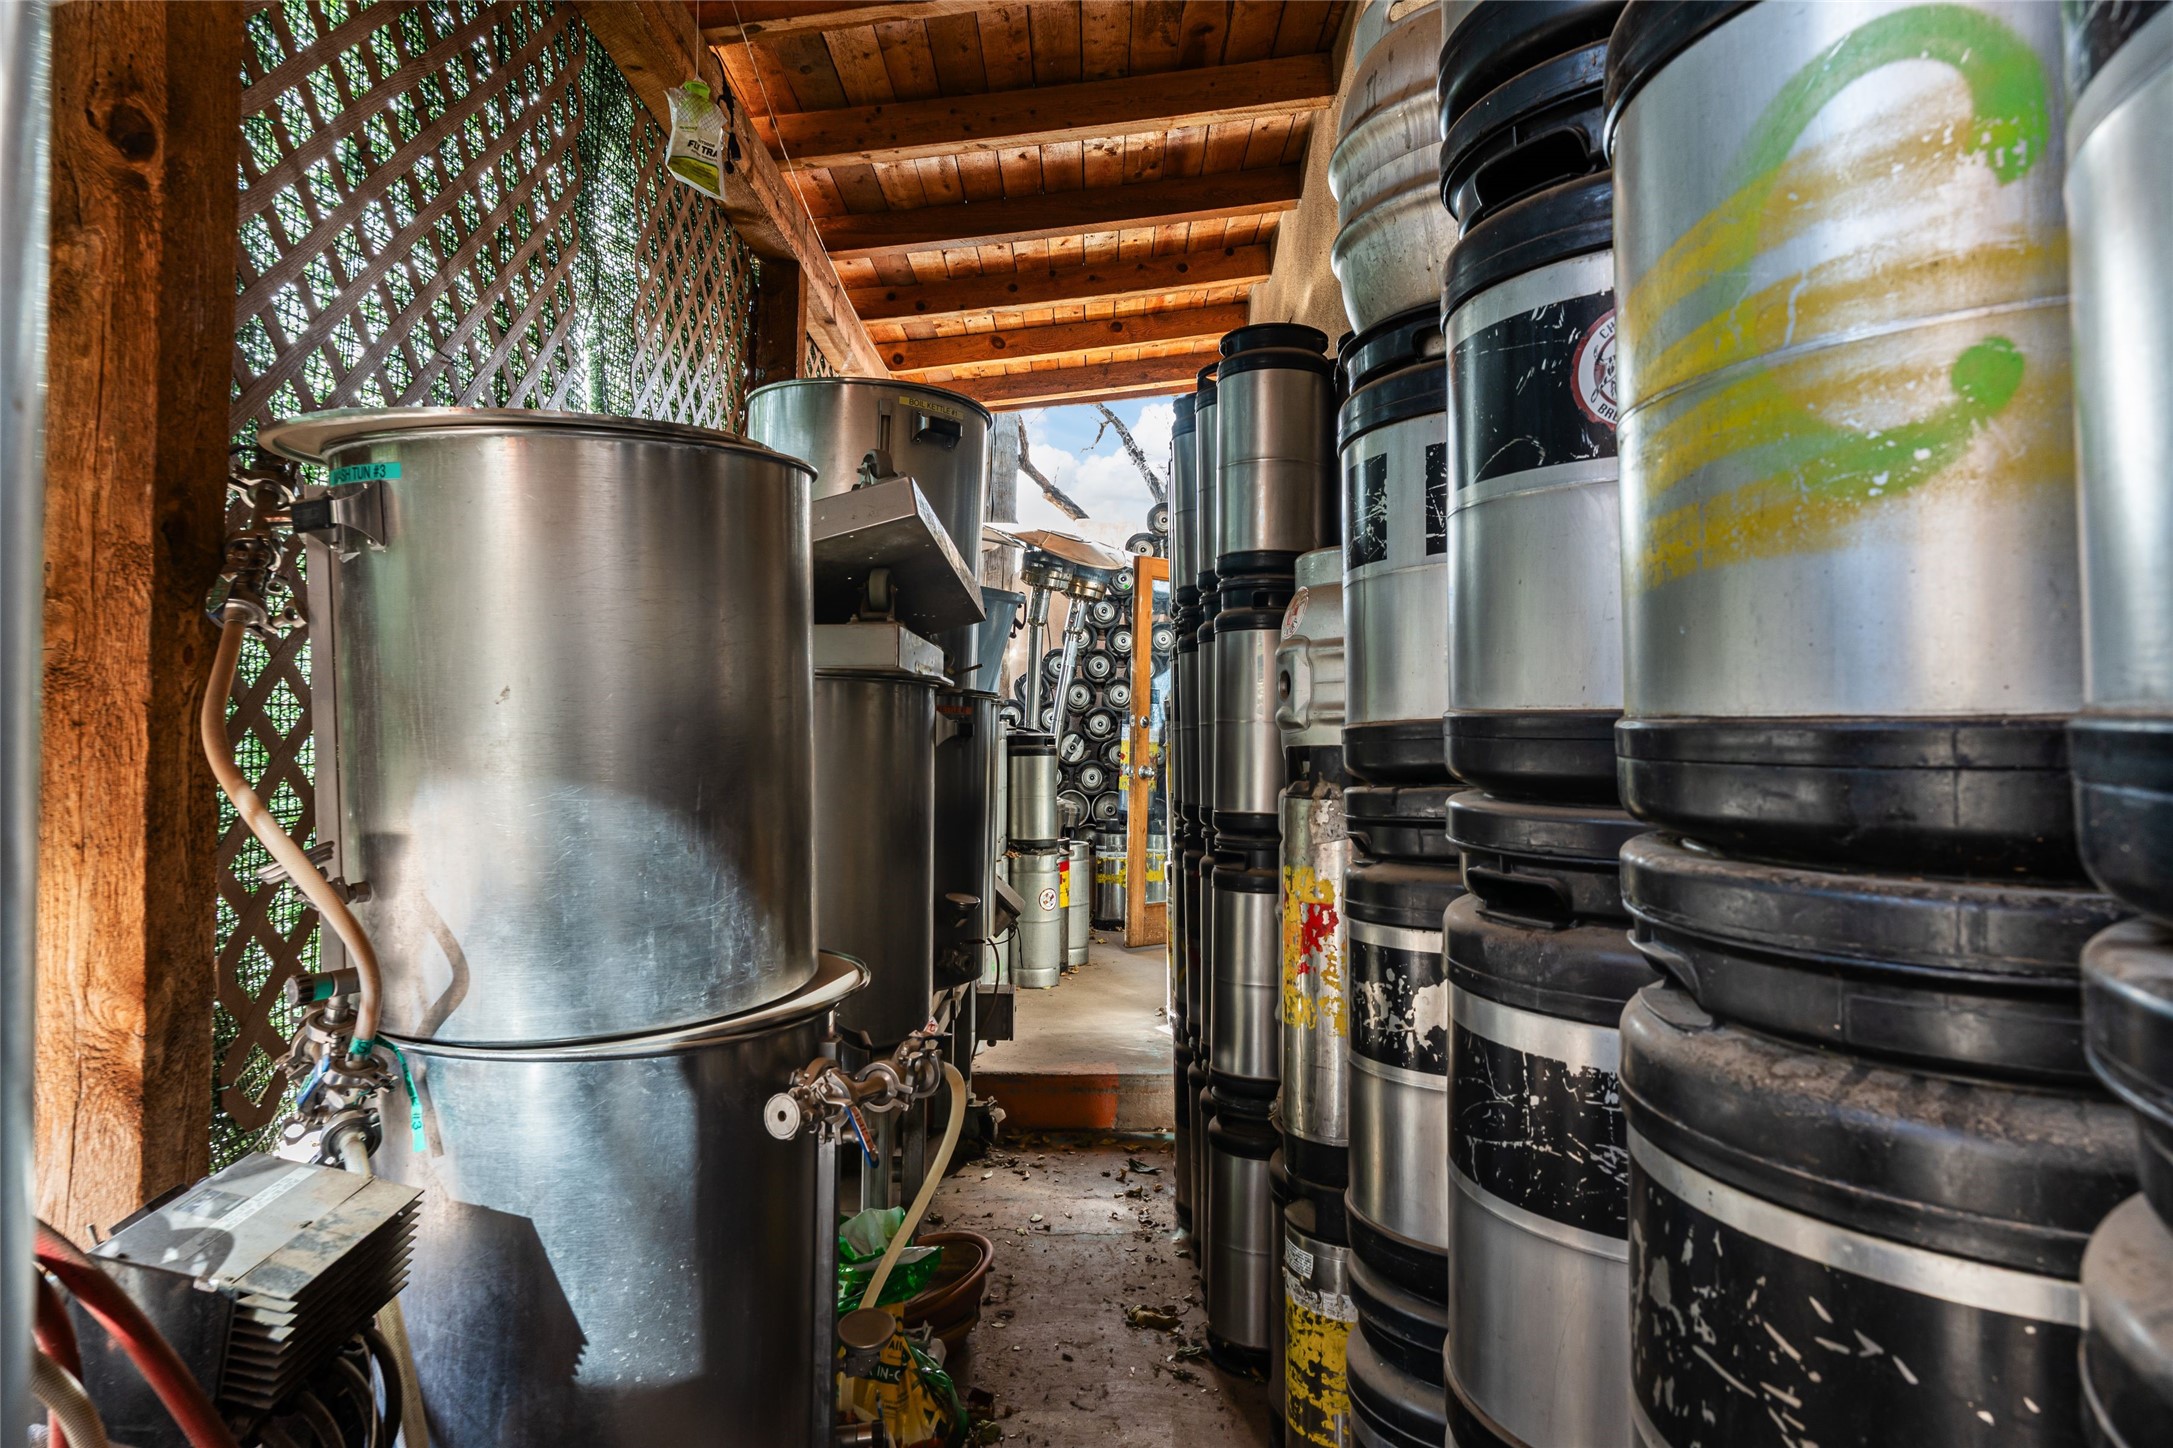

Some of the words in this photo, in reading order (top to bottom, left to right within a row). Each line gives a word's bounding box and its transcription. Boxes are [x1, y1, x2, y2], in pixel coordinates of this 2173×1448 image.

[909, 398, 925, 408] BOIL
[926, 402, 951, 415] KETTLE
[352, 464, 371, 480] TUN
[373, 463, 386, 478] #3
